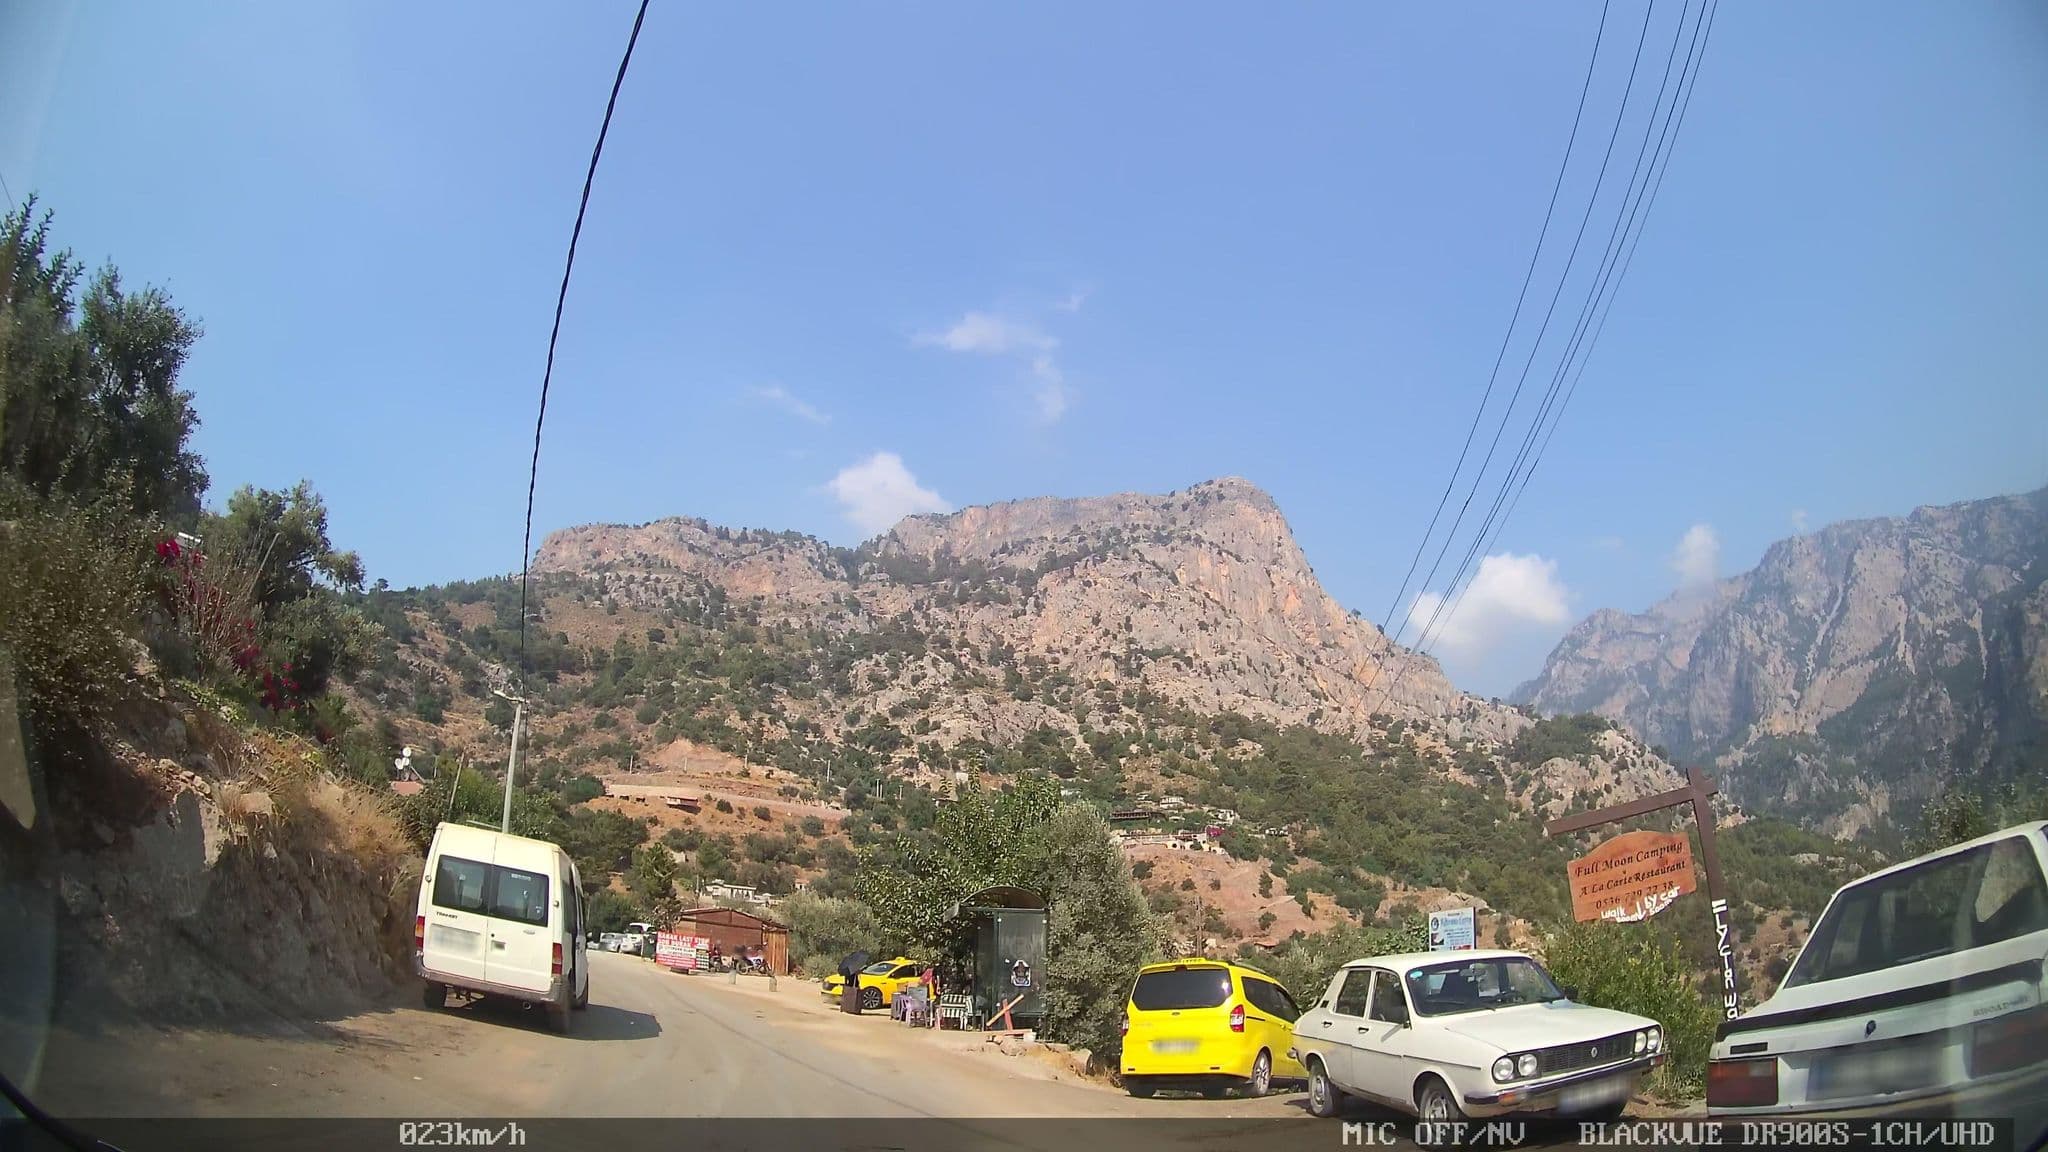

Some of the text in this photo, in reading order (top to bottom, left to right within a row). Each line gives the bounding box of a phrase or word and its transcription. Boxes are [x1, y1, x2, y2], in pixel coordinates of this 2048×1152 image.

[1575, 842, 1682, 877] Full Moon Camping
[1579, 861, 1686, 897] A La Carte Restaurant
[1600, 905, 1627, 919] walk
